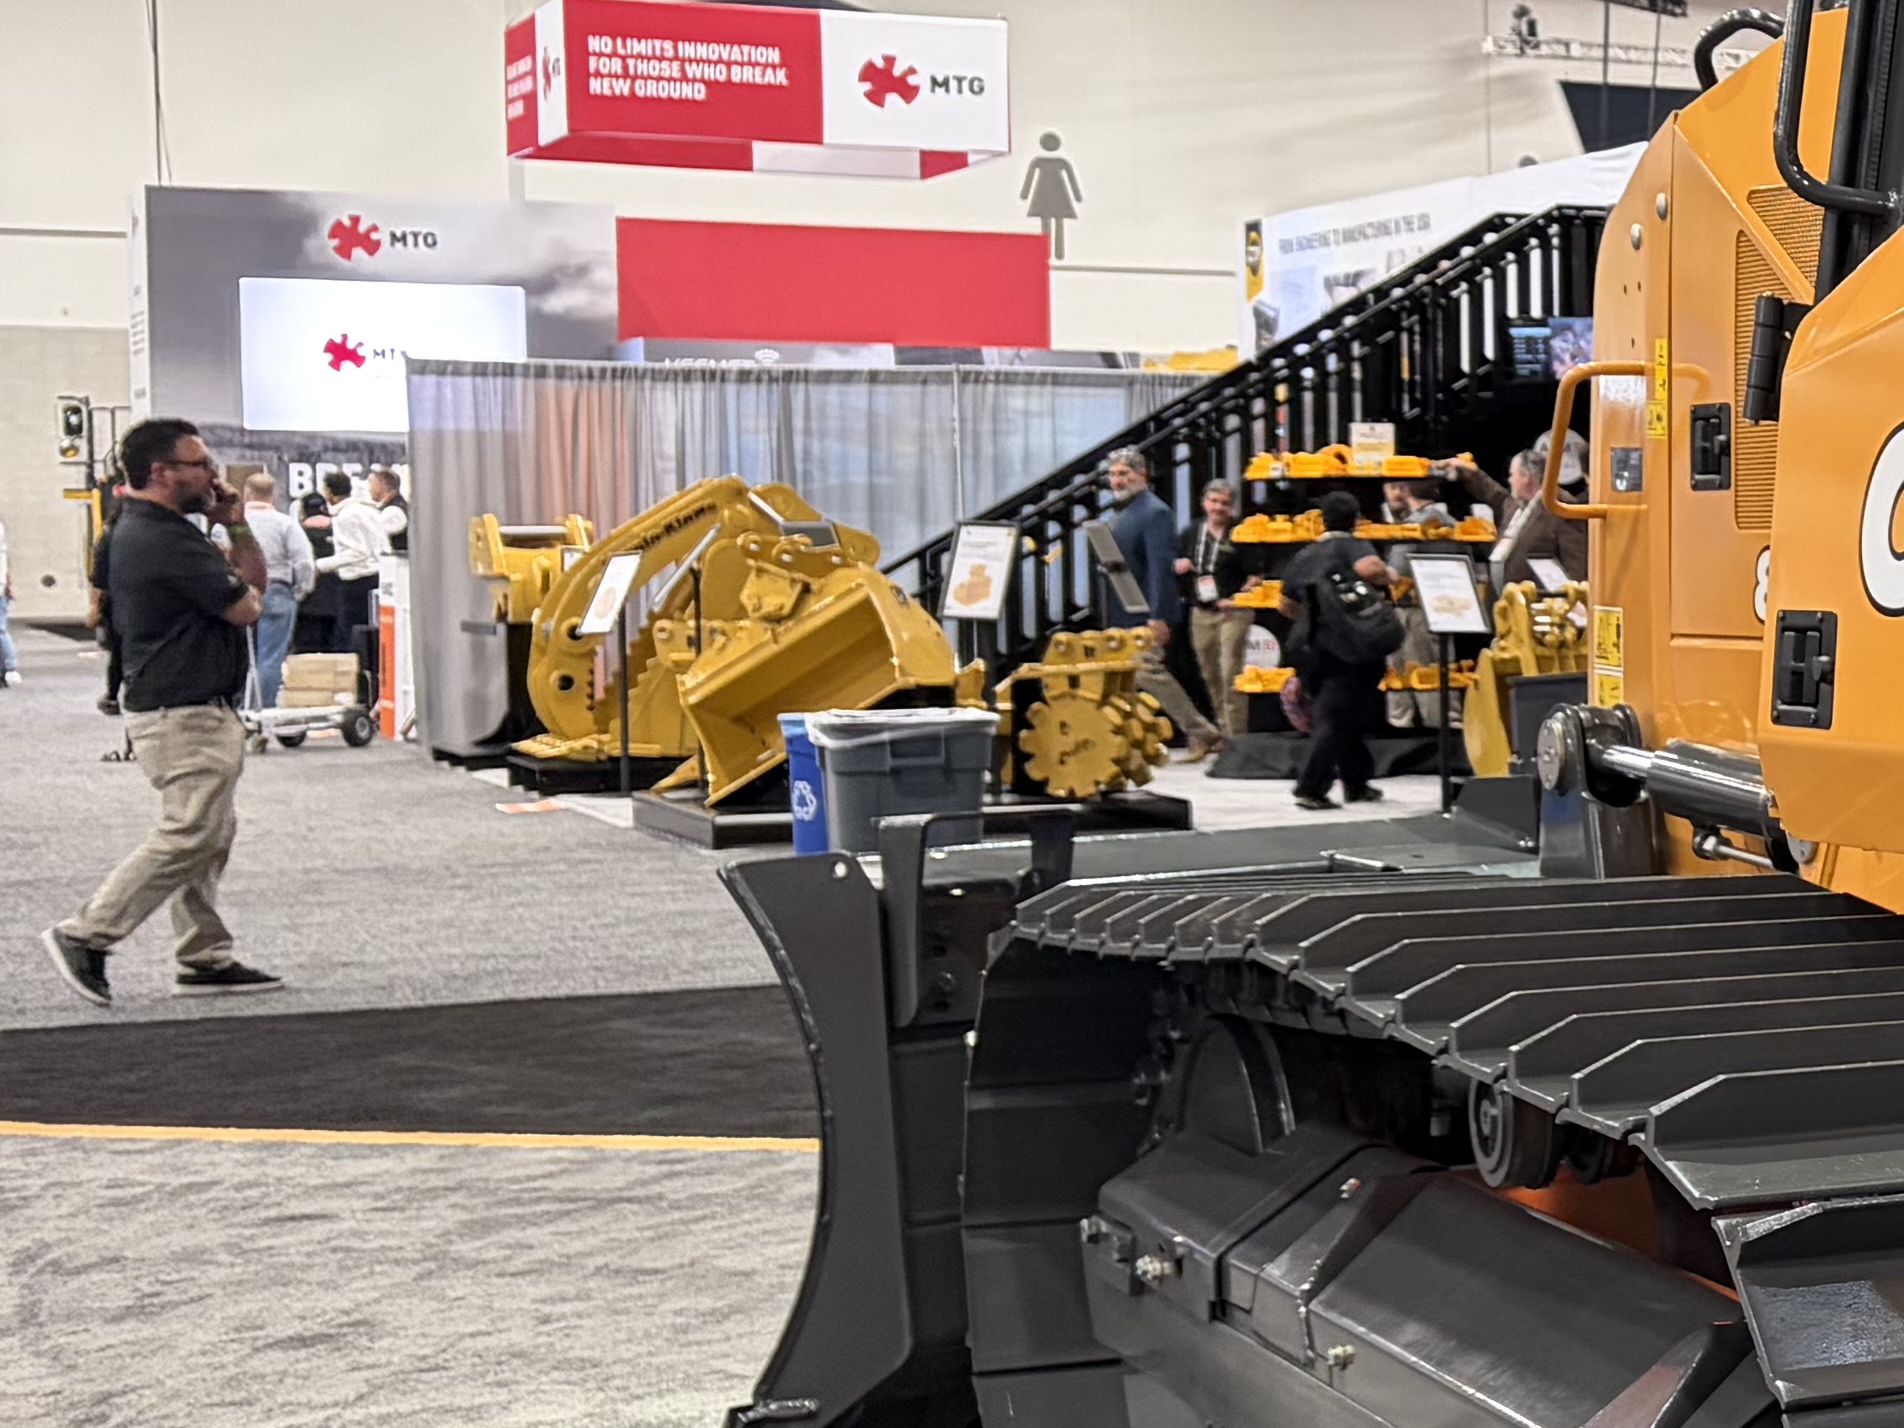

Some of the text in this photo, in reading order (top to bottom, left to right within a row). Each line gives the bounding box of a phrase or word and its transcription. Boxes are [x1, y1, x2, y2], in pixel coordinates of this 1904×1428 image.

[588, 35, 781, 63] NO LIMITS INNOVATION
[589, 56, 788, 86] FOR THOSE WHO BREAK
[589, 77, 707, 101] NEW GROUND
[928, 73, 985, 96] MTG
[389, 230, 438, 250] MTG
